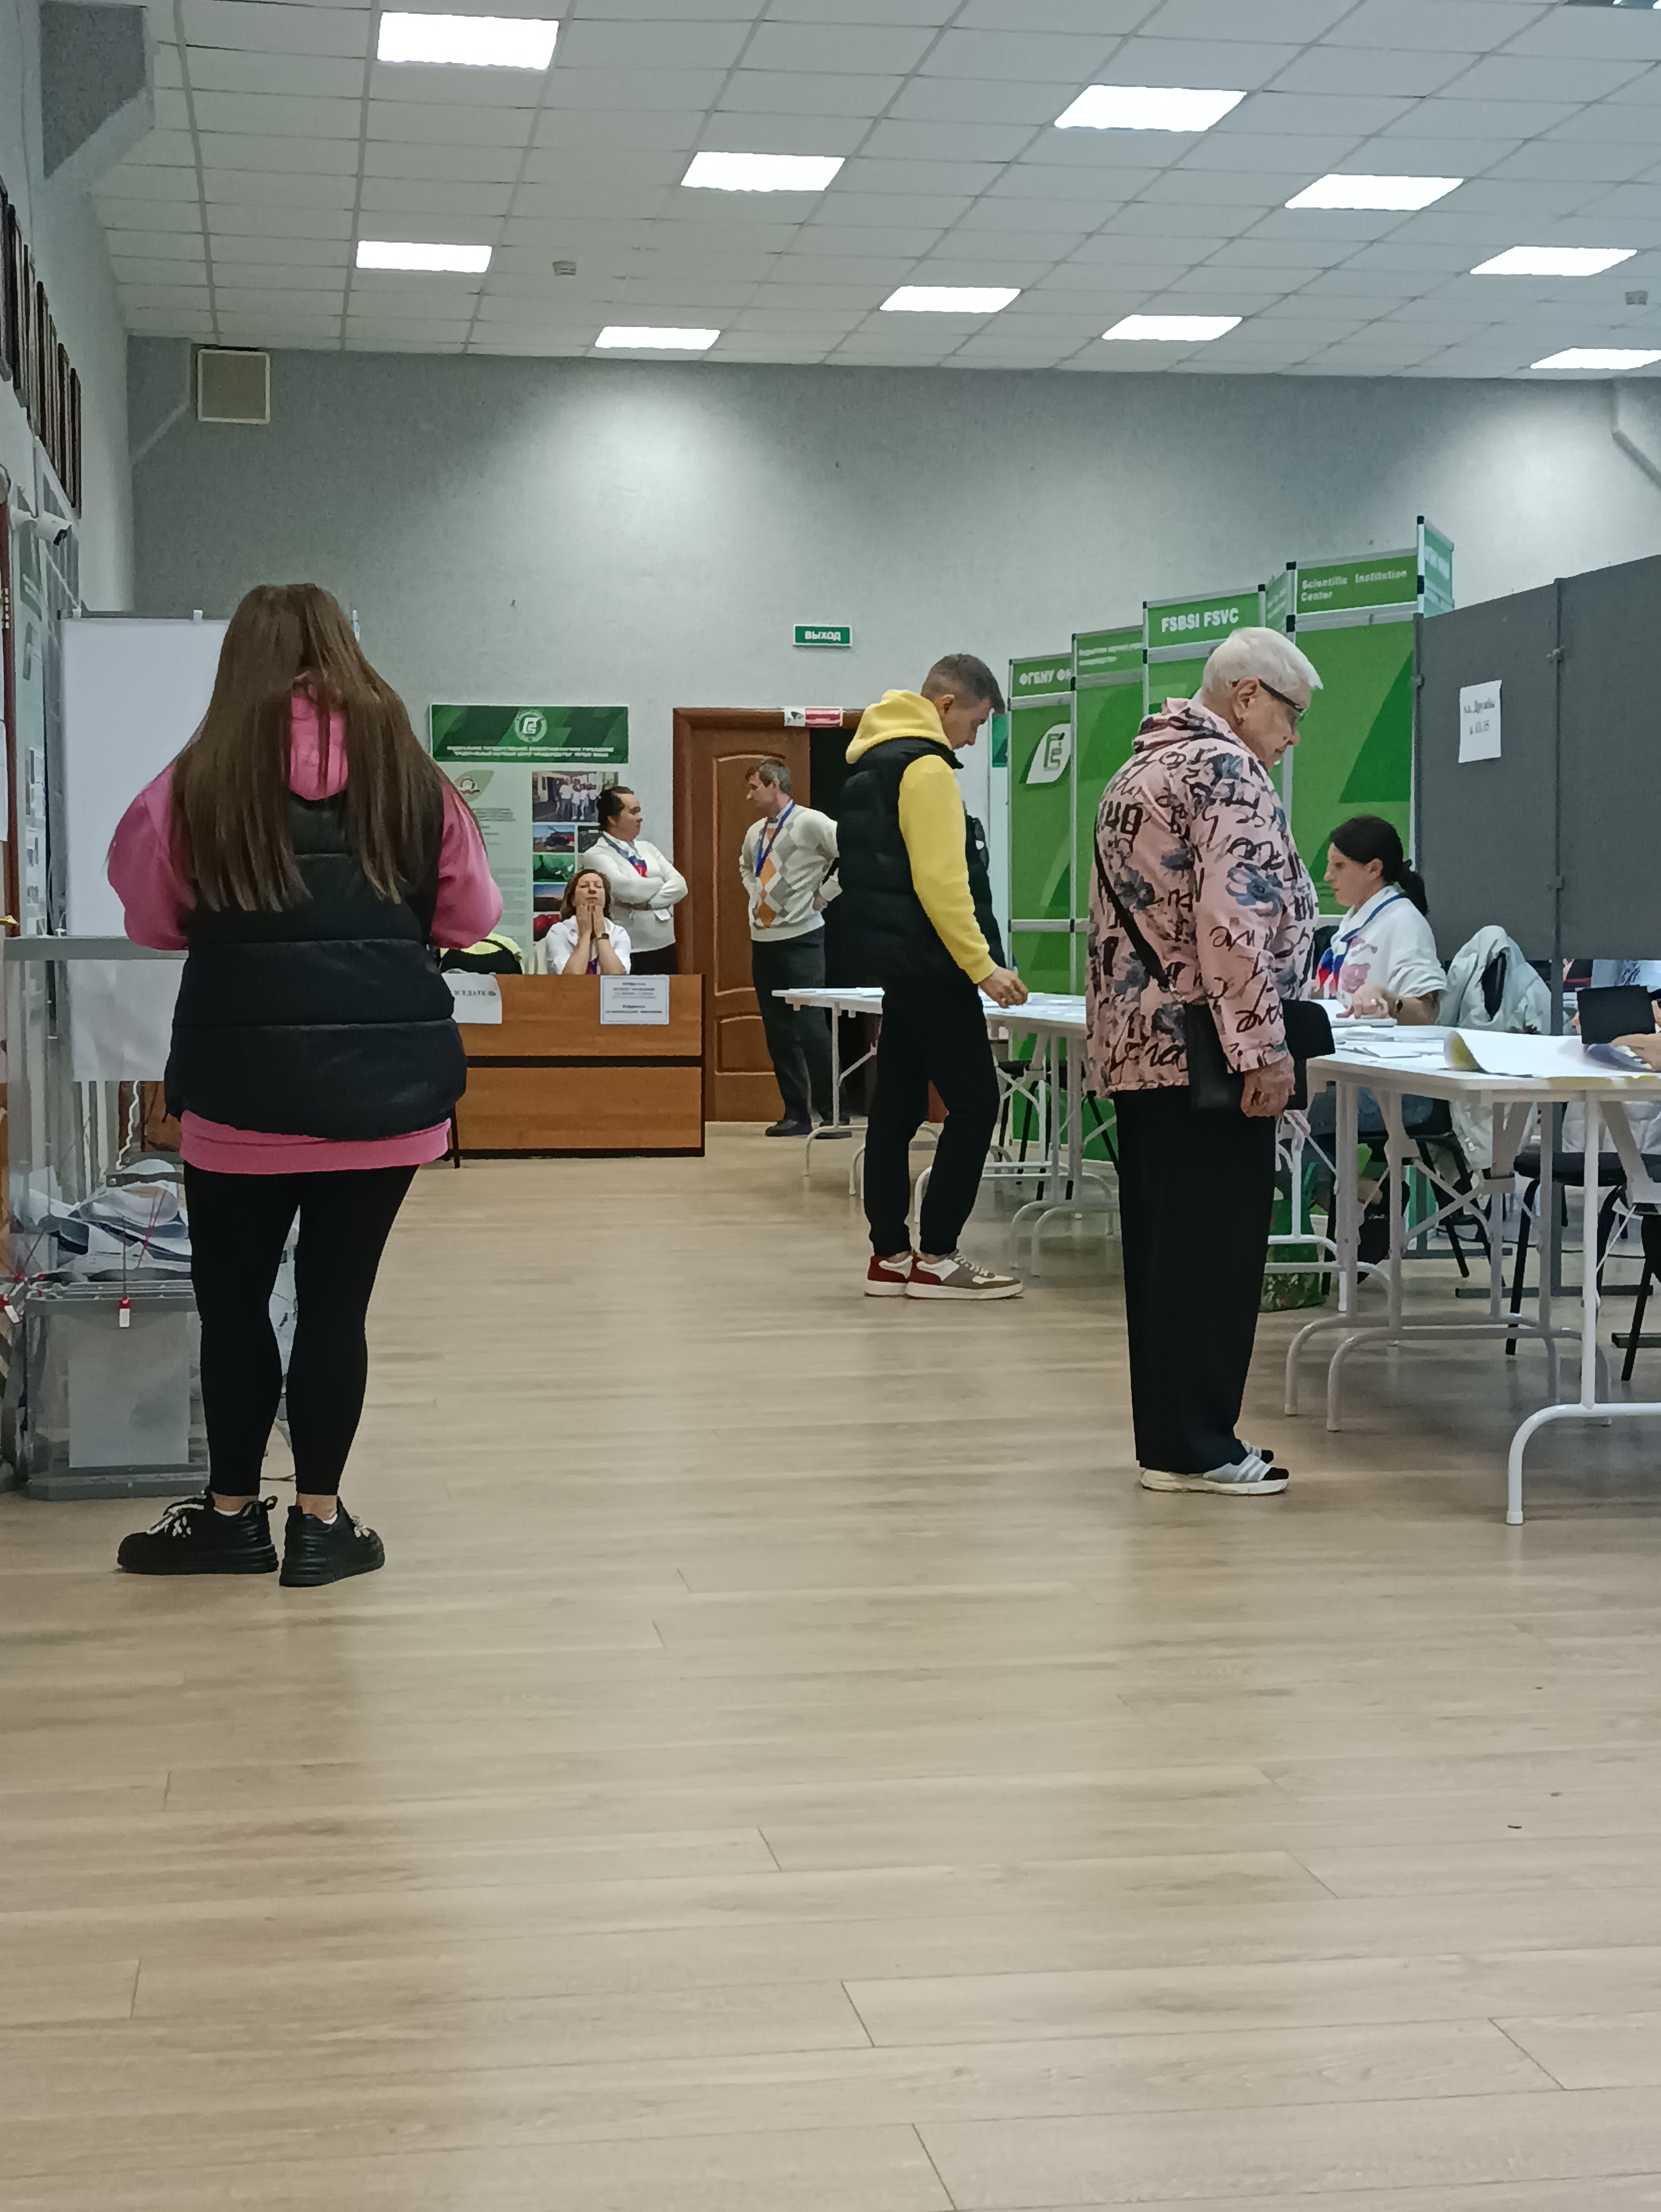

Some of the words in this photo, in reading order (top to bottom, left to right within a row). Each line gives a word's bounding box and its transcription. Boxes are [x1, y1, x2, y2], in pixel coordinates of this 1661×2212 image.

[1161, 613, 1200, 633] FSBSI
[1203, 607, 1239, 628] FSVC
[804, 630, 842, 641] ВЫХОД
